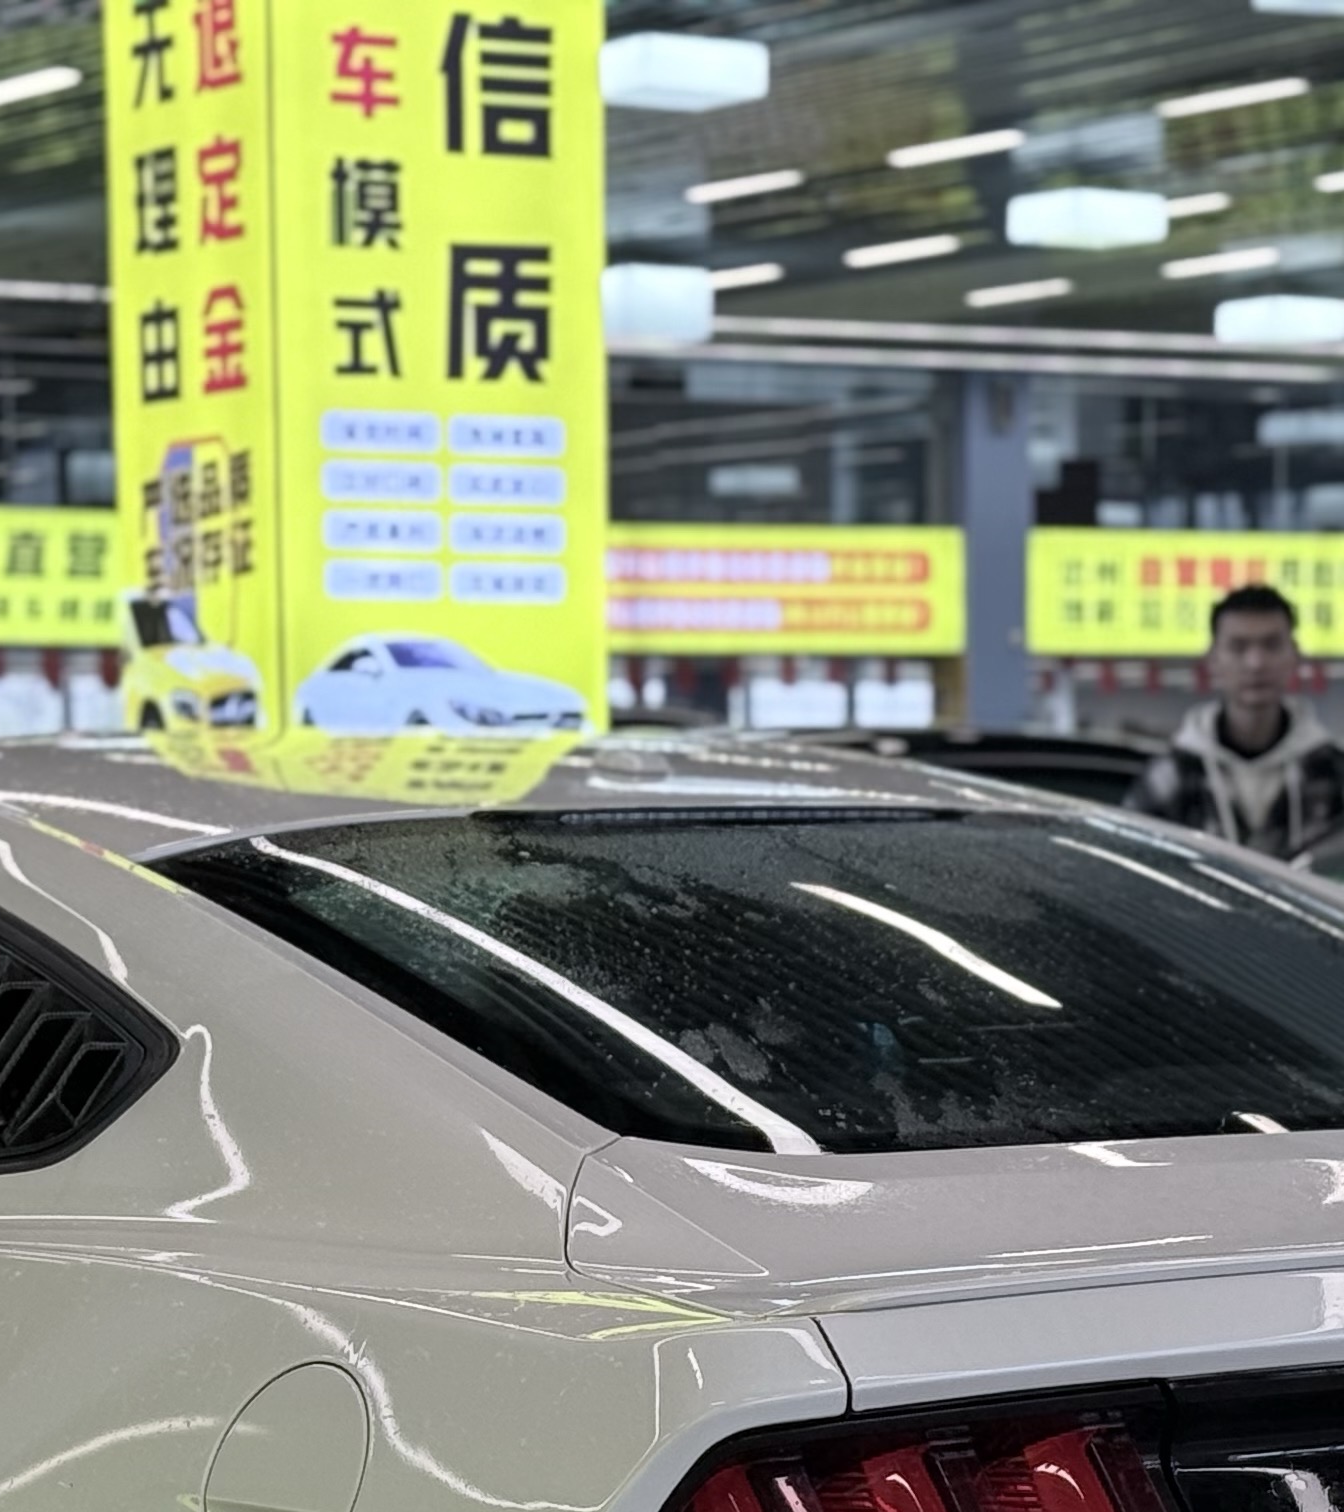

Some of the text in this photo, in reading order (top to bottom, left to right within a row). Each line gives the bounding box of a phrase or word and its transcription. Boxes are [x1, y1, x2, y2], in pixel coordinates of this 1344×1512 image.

[132, 3, 181, 405] 无理由
[193, 0, 248, 395] 退定金
[329, 26, 404, 379] 车模式
[440, 12, 554, 383] 信质
